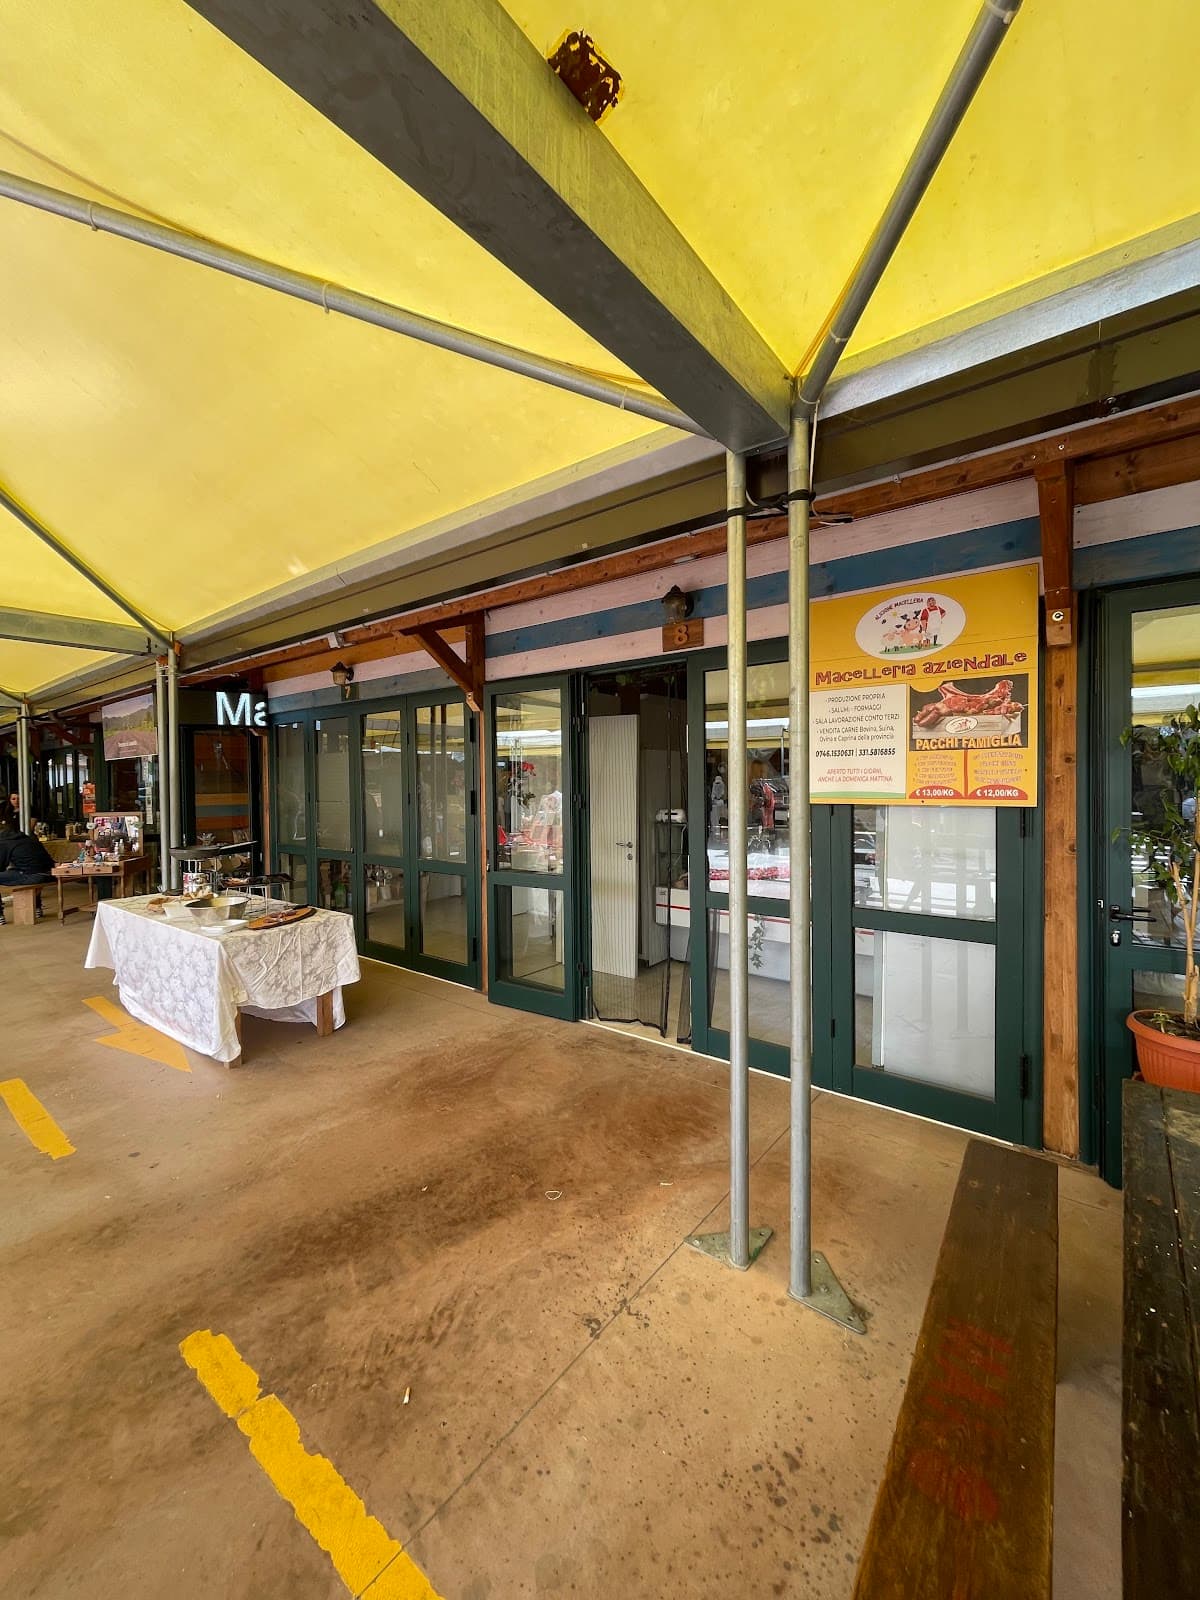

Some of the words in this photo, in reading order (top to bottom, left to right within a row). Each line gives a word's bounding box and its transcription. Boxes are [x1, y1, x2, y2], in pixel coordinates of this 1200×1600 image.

[672, 625, 688, 645] 8
[344, 685, 351, 699] 7
[827, 694, 861, 704] PRODUZIONE
[862, 692, 886, 701] PROPRIA
[815, 717, 828, 725] SALA
[828, 715, 865, 724] LAVORAZIONE
[865, 714, 884, 722] CONTO
[842, 726, 859, 734] CARNE
[915, 737, 959, 751] PACCHI
[961, 733, 1023, 750] FAMIGLIA
